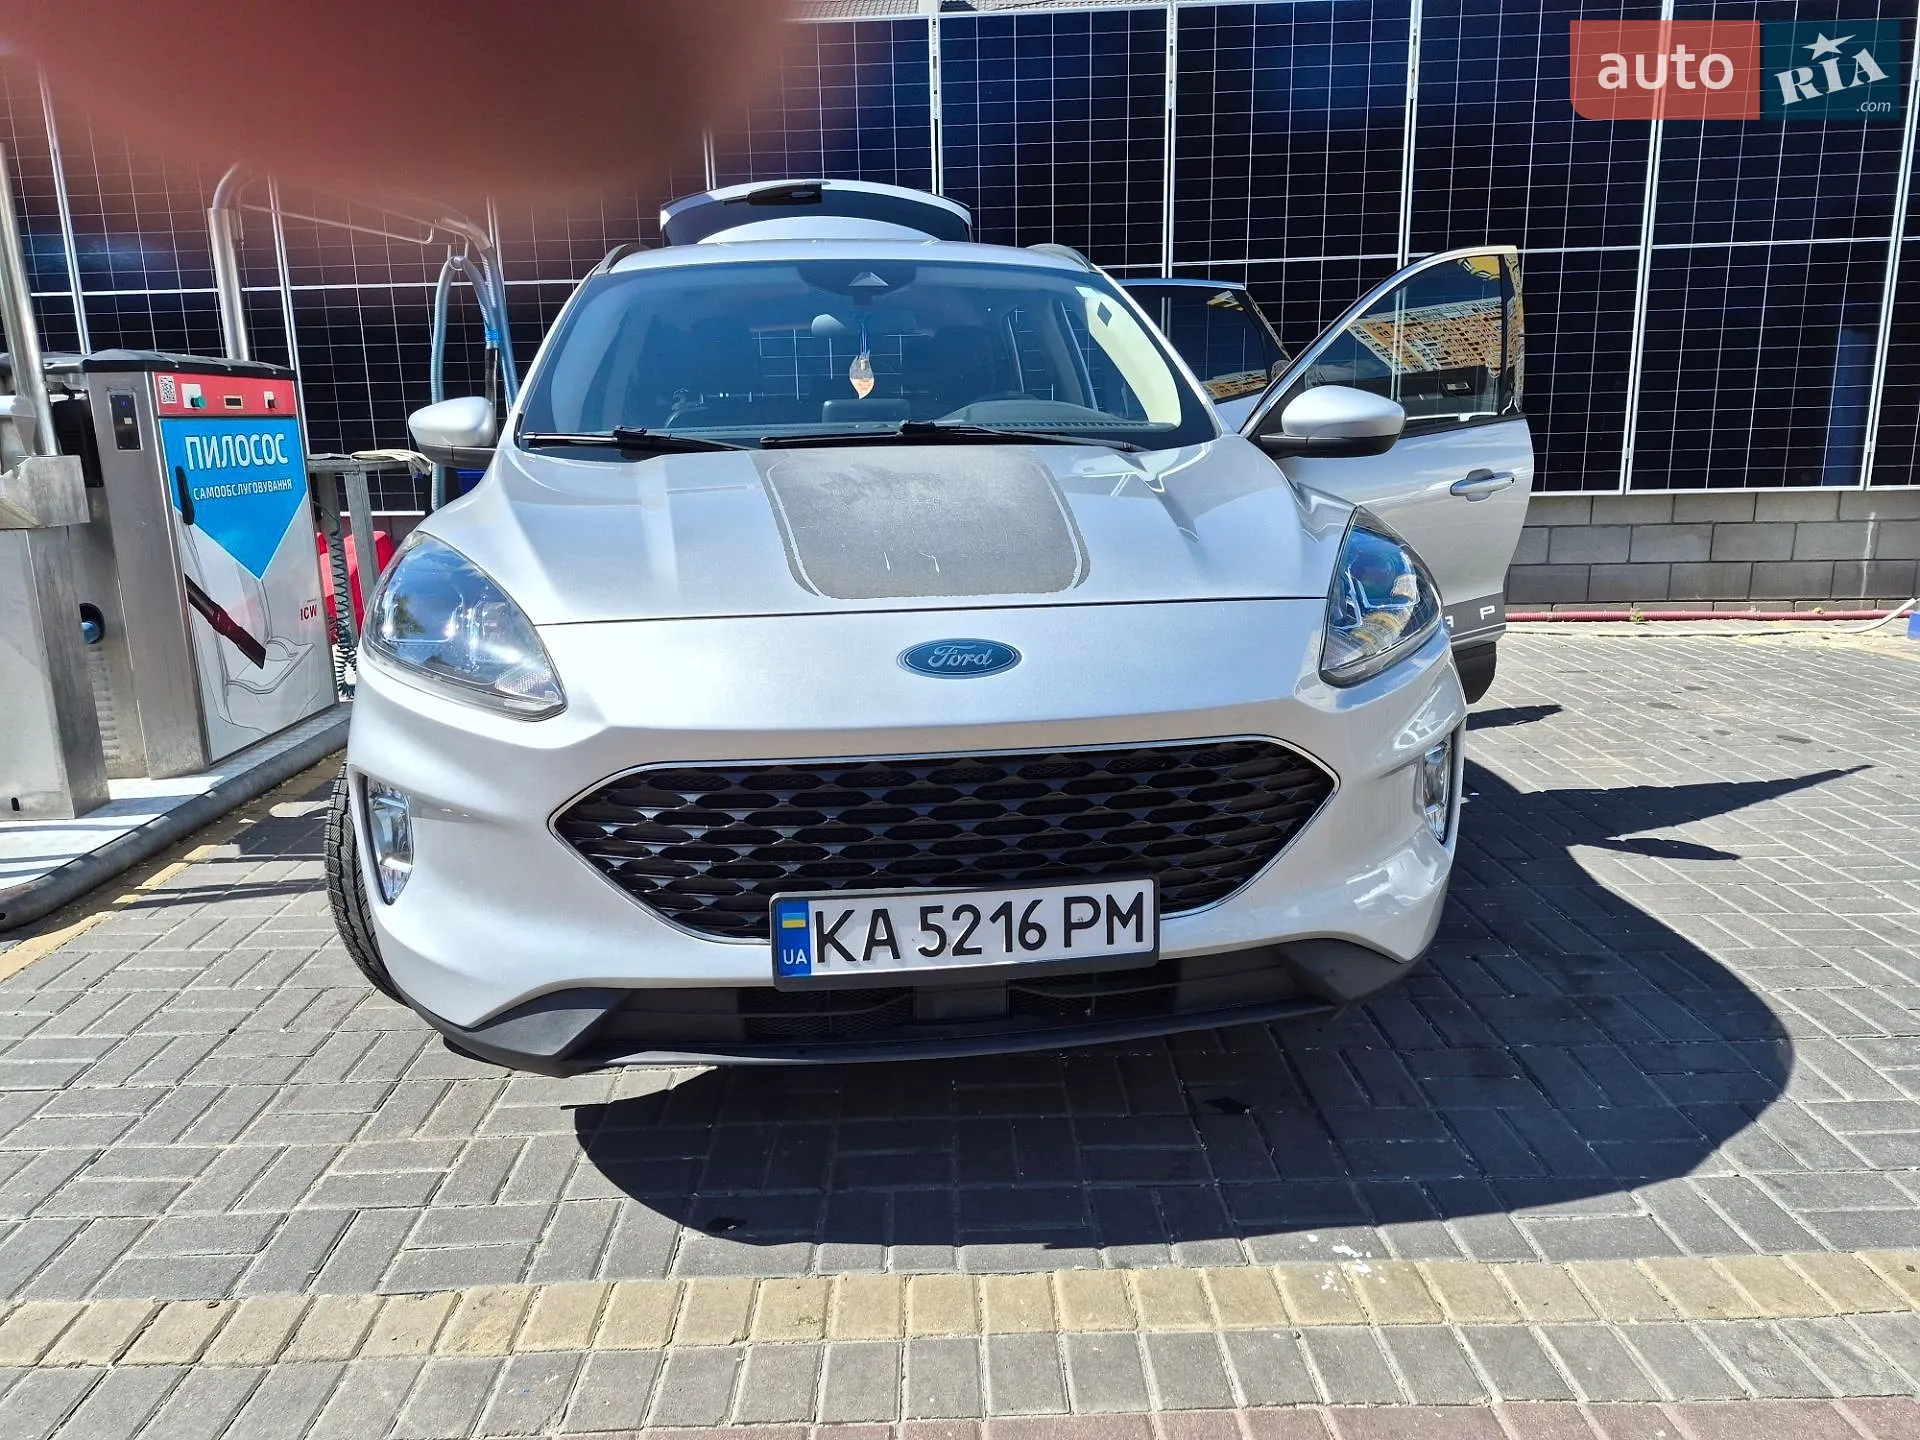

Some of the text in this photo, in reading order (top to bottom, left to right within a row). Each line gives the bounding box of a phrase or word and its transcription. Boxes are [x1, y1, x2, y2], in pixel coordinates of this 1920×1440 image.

[184, 434, 288, 470] ПИЛОСОС
[193, 479, 292, 500] САМООБСЛУГОВУВАННЯ
[300, 604, 317, 621] ICW
[928, 645, 993, 667] Ford
[814, 892, 1144, 963] KA 5216 PM
[783, 948, 807, 965] UA
